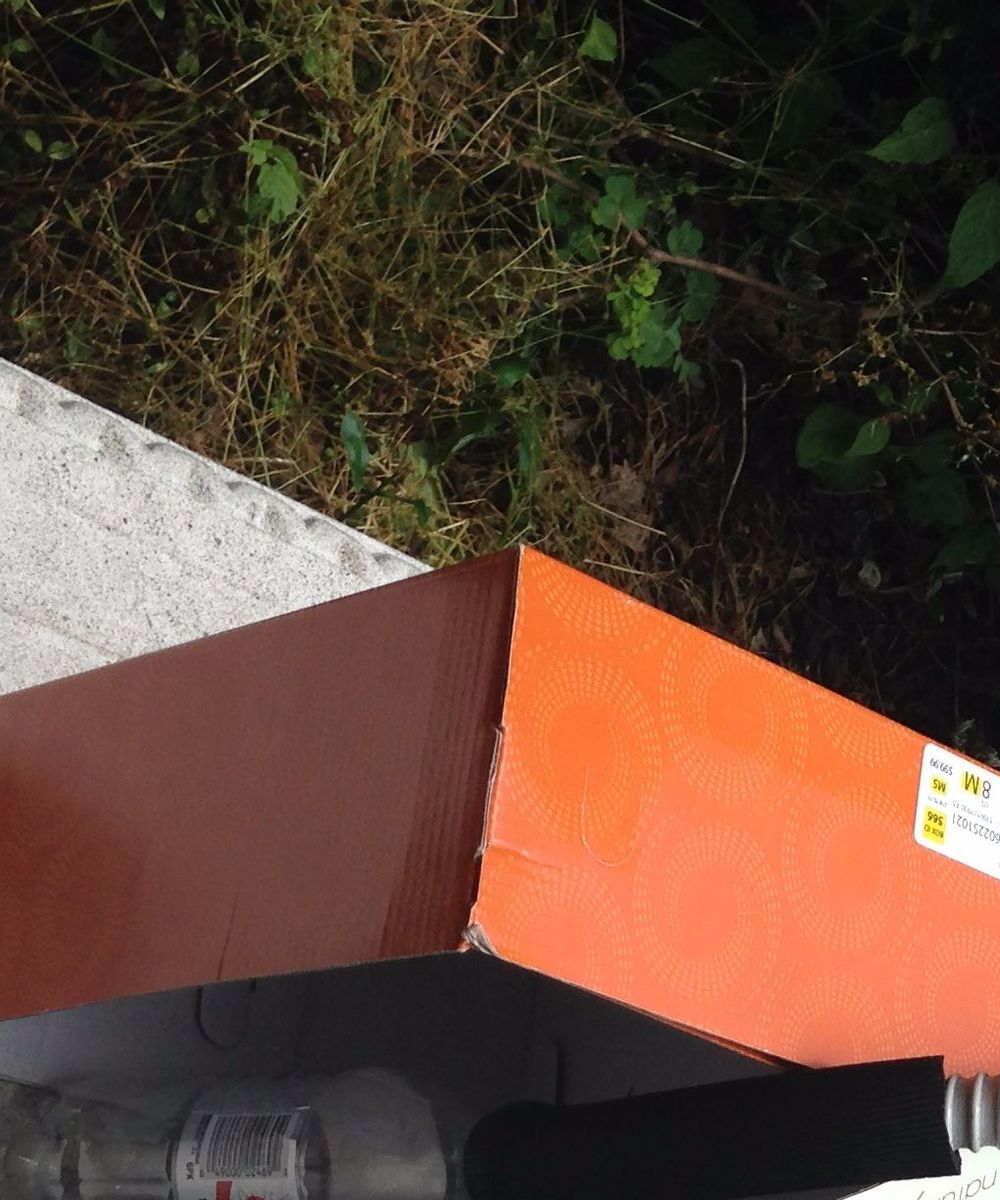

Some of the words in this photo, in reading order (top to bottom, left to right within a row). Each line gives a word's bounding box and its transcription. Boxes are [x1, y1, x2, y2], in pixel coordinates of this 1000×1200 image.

[964, 771, 980, 796] M
[982, 780, 992, 799] 8
[927, 810, 944, 827] 566
